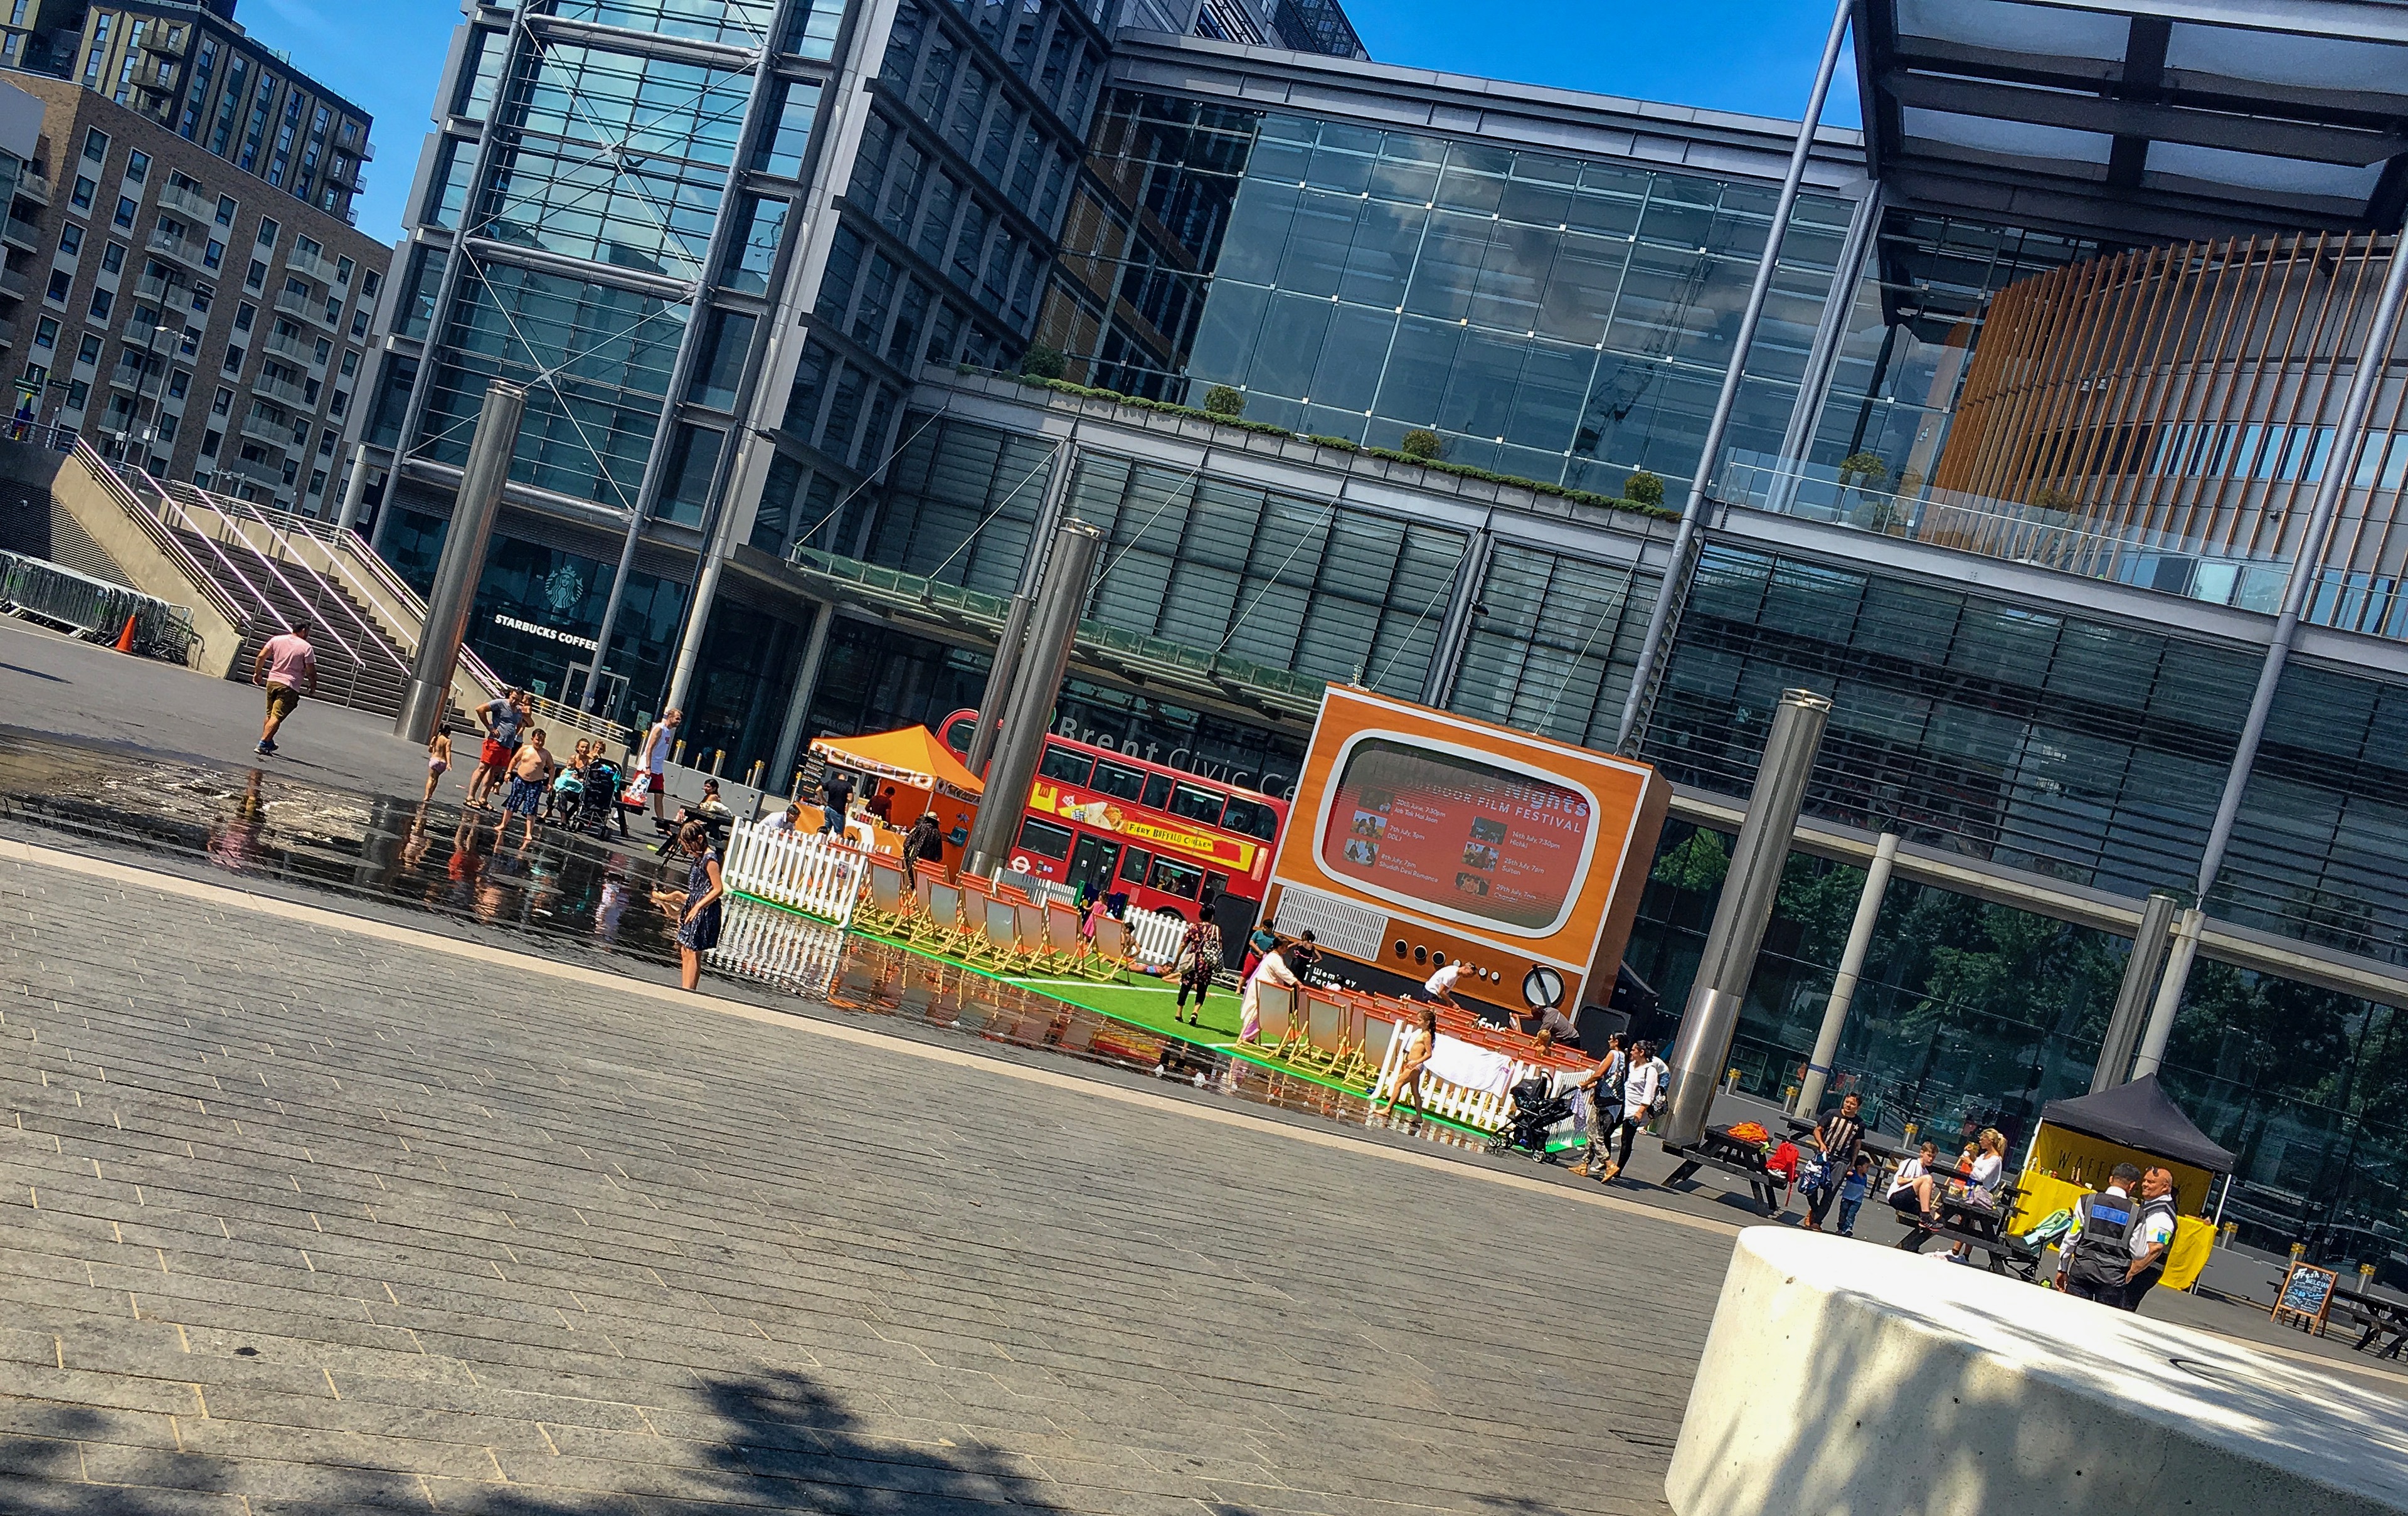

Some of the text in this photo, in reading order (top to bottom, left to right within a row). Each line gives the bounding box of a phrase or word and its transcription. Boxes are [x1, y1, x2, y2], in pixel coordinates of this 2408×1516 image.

[495, 614, 598, 651] STARBUCKS COFFEE
[1058, 716, 1159, 761] Brent
[1169, 748, 1248, 787] Civic
[1504, 781, 1588, 817] Nights
[1424, 807, 1446, 817] 7:30pm
[1477, 797, 1510, 813] FILM
[1515, 807, 1581, 833] FESTIVAL
[1153, 829, 1182, 842] BUFFALO
[1389, 825, 1399, 833] 7th
[1412, 831, 1425, 840] 3pm
[1512, 831, 1525, 839] 14th
[1539, 838, 1560, 849] 7:30pm
[1404, 860, 1416, 868] 7pm
[1504, 857, 1518, 866] 25th
[1531, 865, 1544, 874] 7pm
[1496, 884, 1510, 893] 29th
[1313, 967, 1357, 988] Wemey
[2292, 1268, 2320, 1280] Fresh
